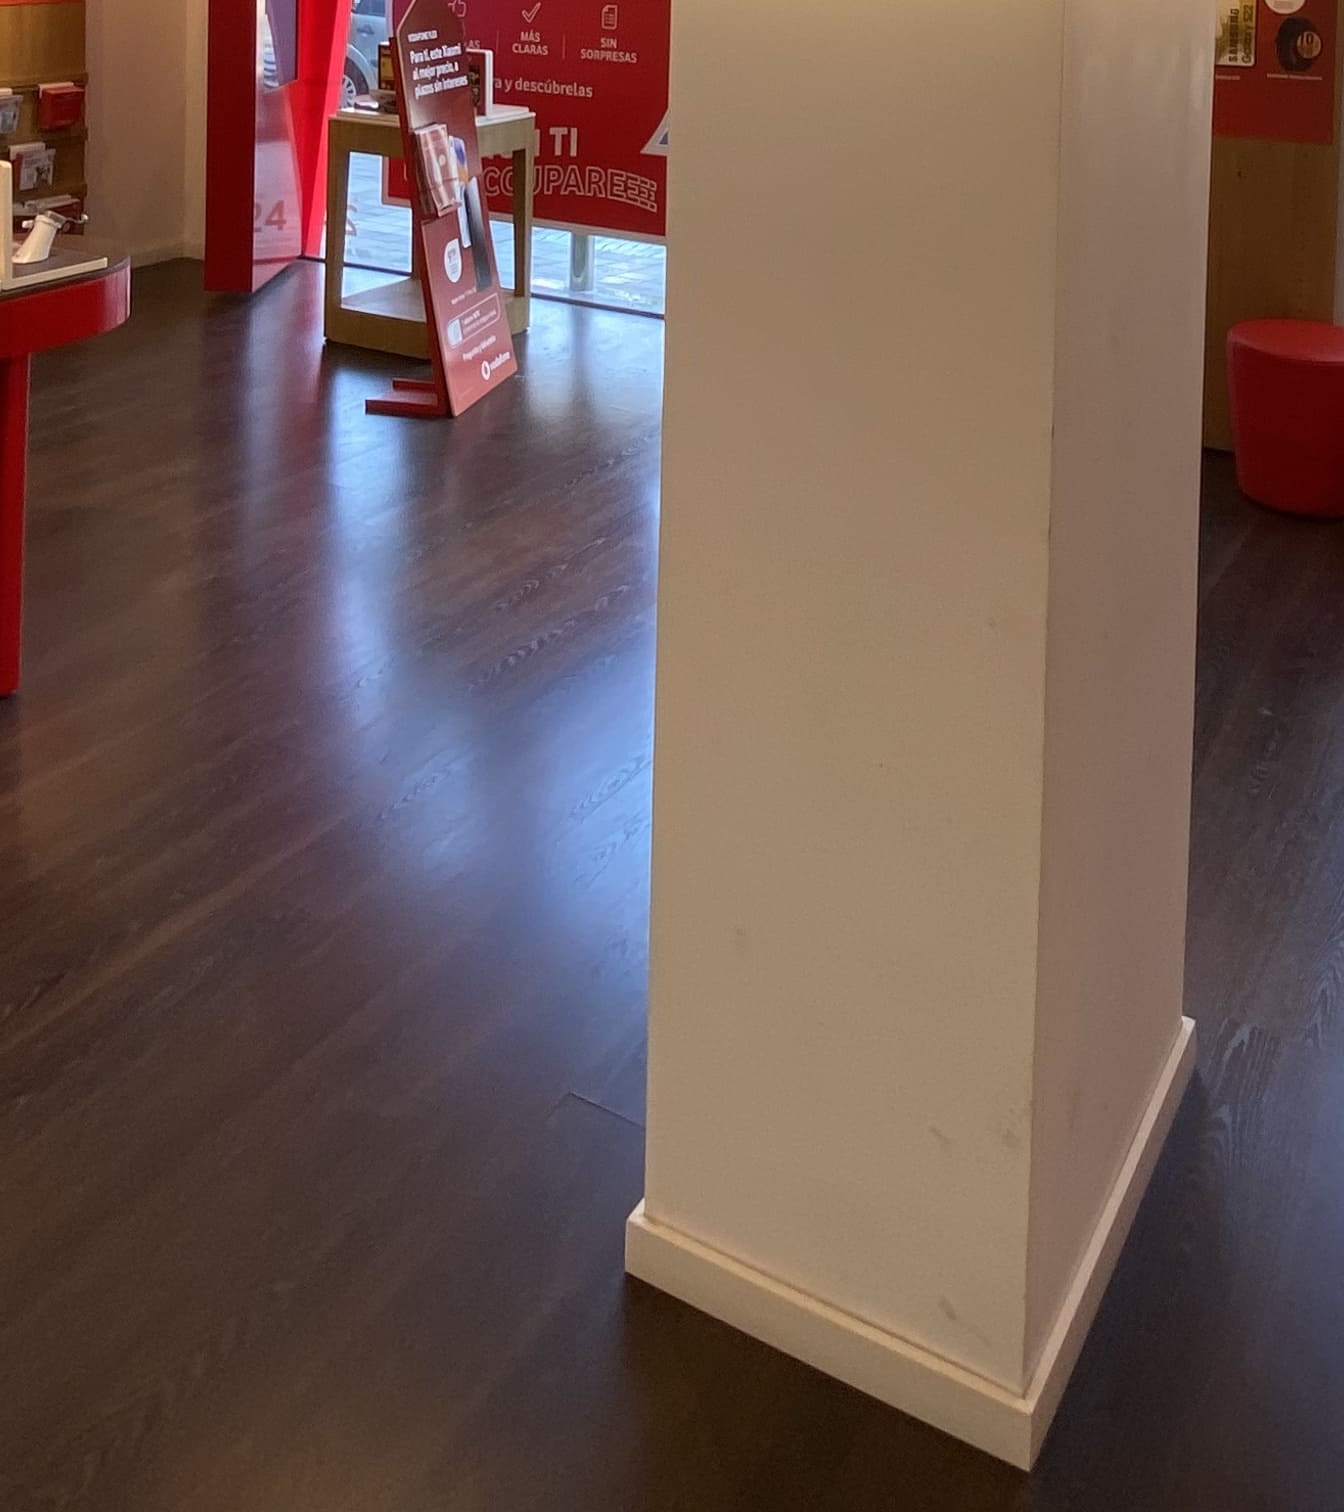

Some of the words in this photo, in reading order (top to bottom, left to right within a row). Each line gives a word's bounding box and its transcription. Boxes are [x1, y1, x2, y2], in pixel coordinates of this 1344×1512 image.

[520, 29, 541, 43] MÁS
[600, 37, 617, 49] SIN
[512, 42, 548, 55] CLARAS
[580, 48, 638, 64] SORPRESAS
[505, 79, 513, 93] y
[515, 76, 594, 99] descúbrelas
[549, 126, 579, 158] TI
